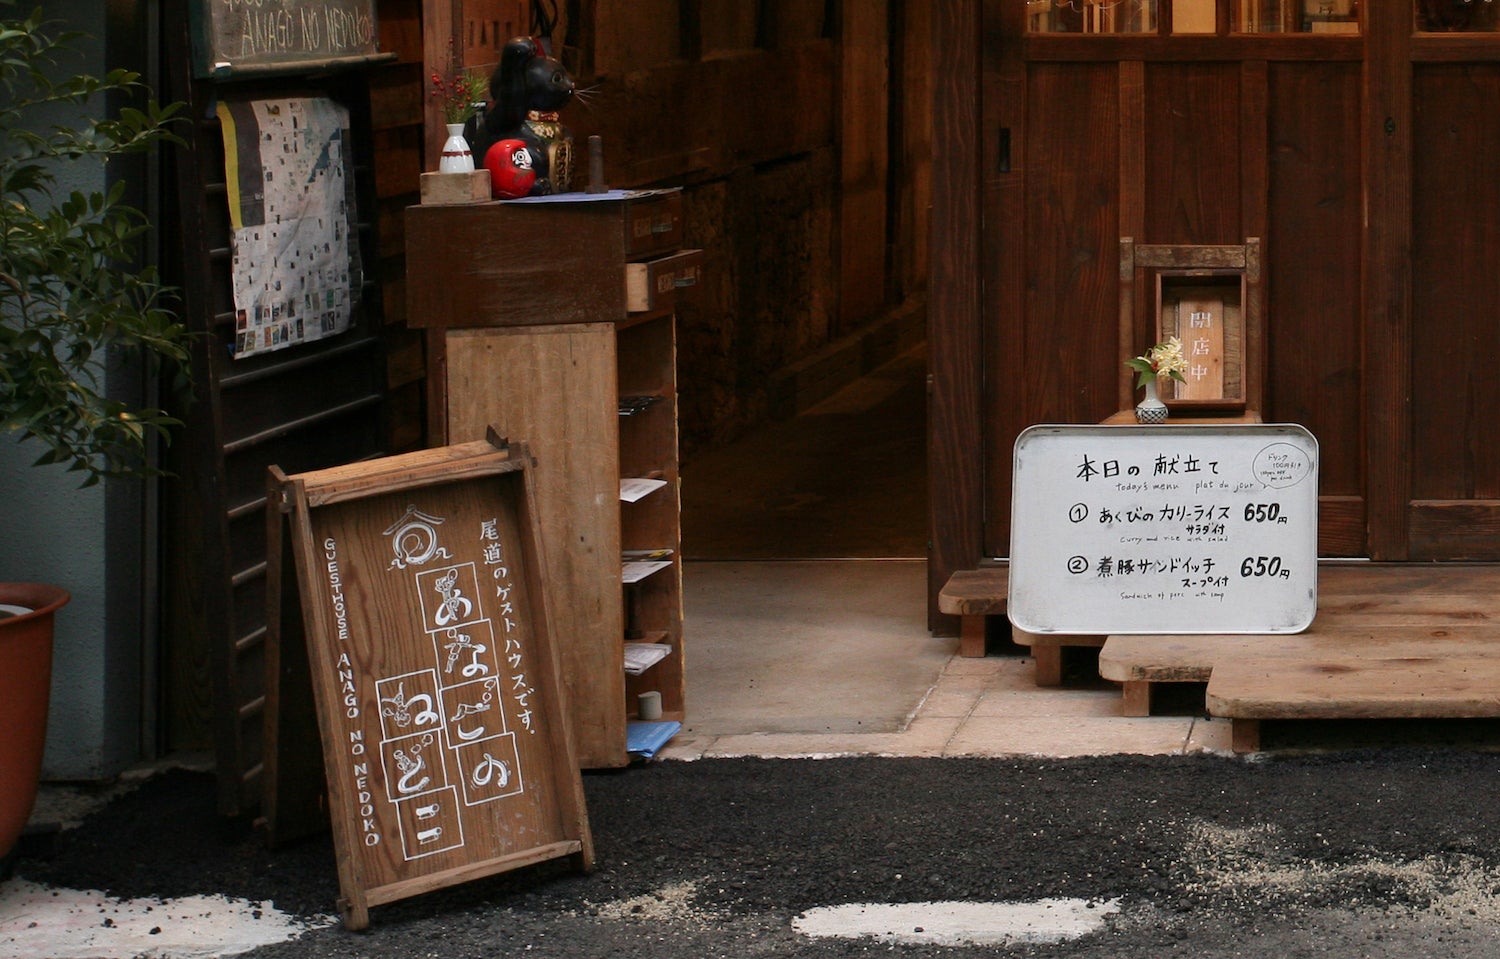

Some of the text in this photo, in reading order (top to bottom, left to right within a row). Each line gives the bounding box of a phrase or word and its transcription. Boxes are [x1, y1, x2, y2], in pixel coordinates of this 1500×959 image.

[241, 4, 371, 60] ANAGO NO NEDOKO
[1190, 311, 1211, 381] 開店中
[1116, 481, 1148, 493] today's
[1195, 480, 1214, 494] plat
[1219, 480, 1229, 488] du
[1233, 481, 1254, 493] jour
[1243, 502, 1288, 524] 650円
[1185, 522, 1225, 535] サラダ付
[1096, 555, 1216, 578] 煮豚サンドイッチ
[1240, 555, 1291, 580] 650円
[1181, 575, 1229, 588] スープ付
[323, 537, 380, 847] GUESTHOUSE ANAGO NO NEDOKO
